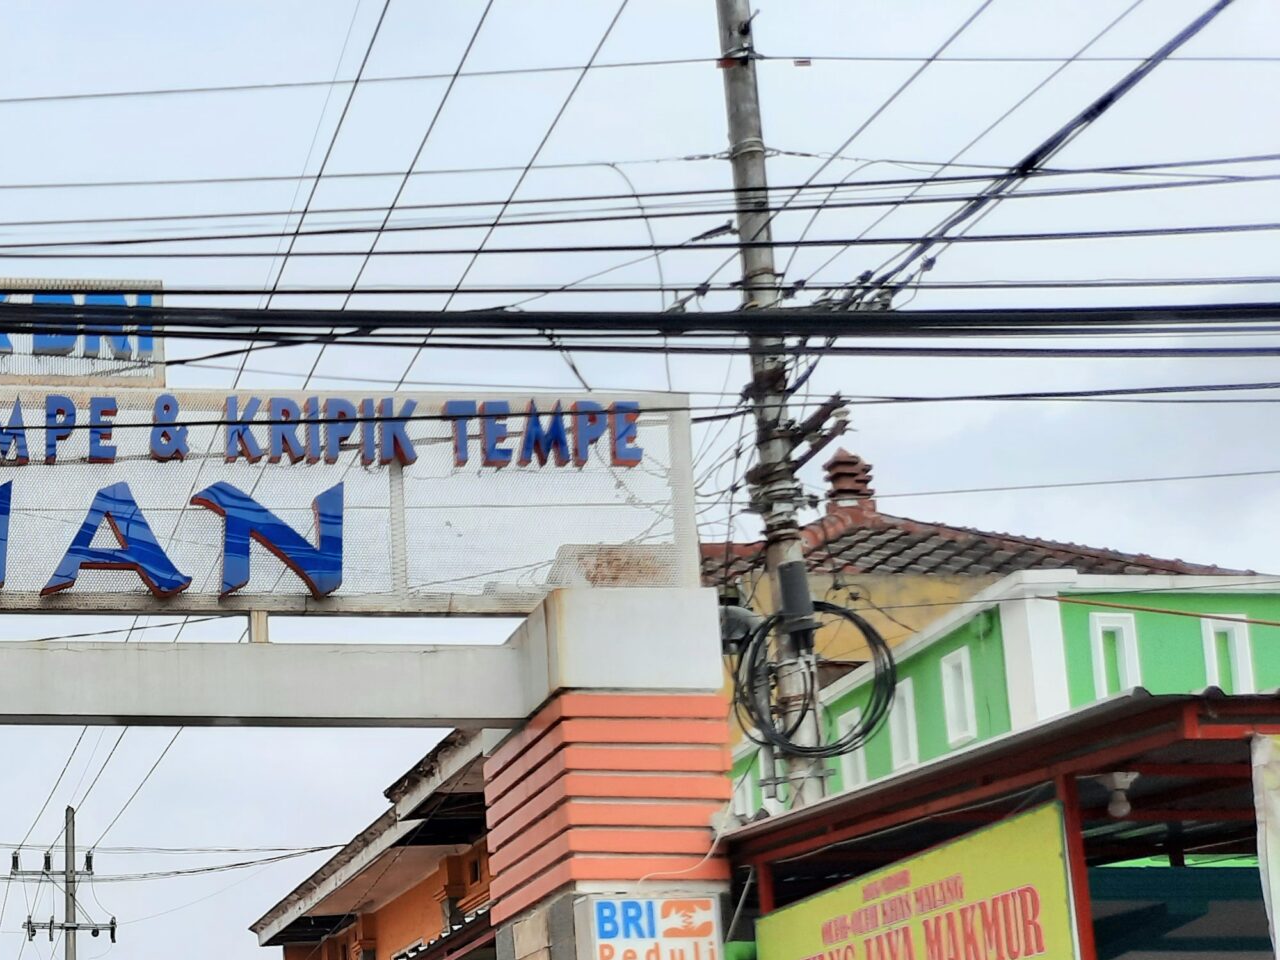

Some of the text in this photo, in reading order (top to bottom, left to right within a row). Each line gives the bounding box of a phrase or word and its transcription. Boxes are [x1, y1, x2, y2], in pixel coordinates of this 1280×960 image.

[150, 394, 190, 461] &
[224, 396, 418, 467] KRIPIK
[441, 400, 644, 468] TEMPE
[596, 900, 656, 939] BRI
